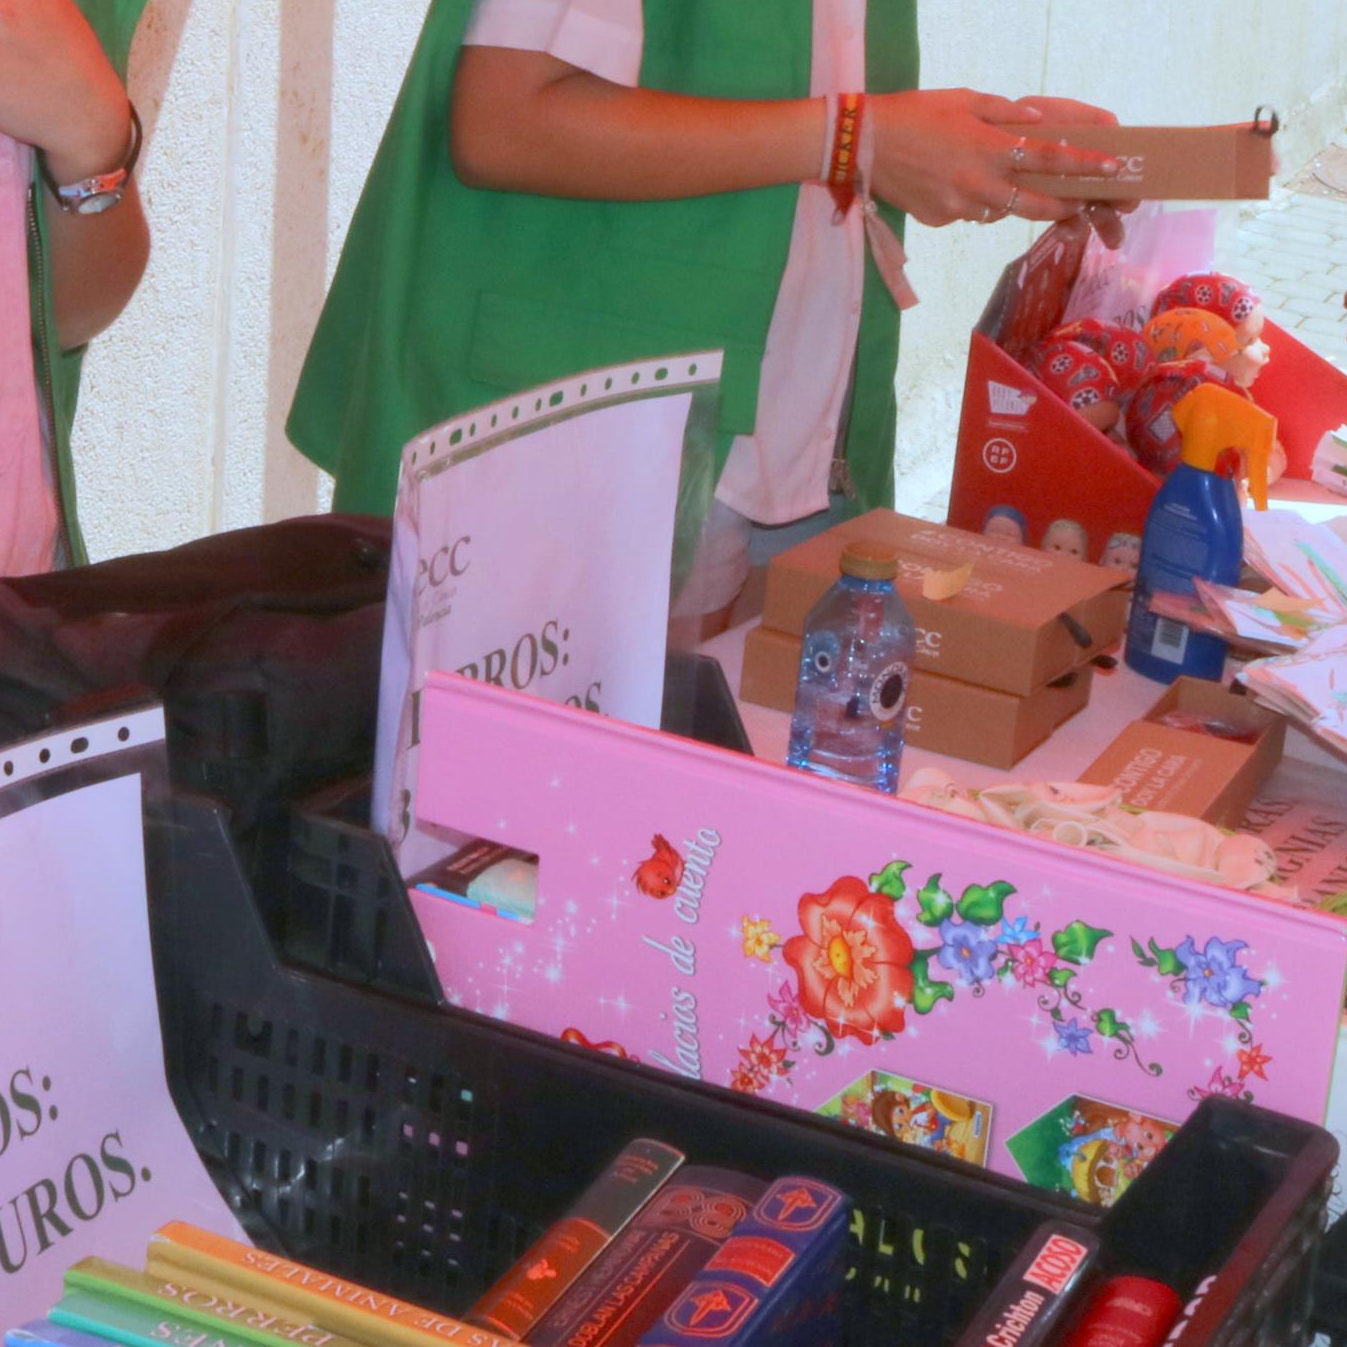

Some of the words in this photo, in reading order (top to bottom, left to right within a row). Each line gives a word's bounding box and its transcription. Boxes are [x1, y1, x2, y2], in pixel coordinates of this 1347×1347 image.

[642, 935, 696, 976] de
[673, 827, 723, 924] cuento
[243, 1252, 410, 1317] ANIMALES
[1029, 1239, 1084, 1292] ACOSO
[158, 1282, 334, 1347] PERROS
[413, 1316, 461, 1337] DE
[985, 1290, 1045, 1347] Crichton
